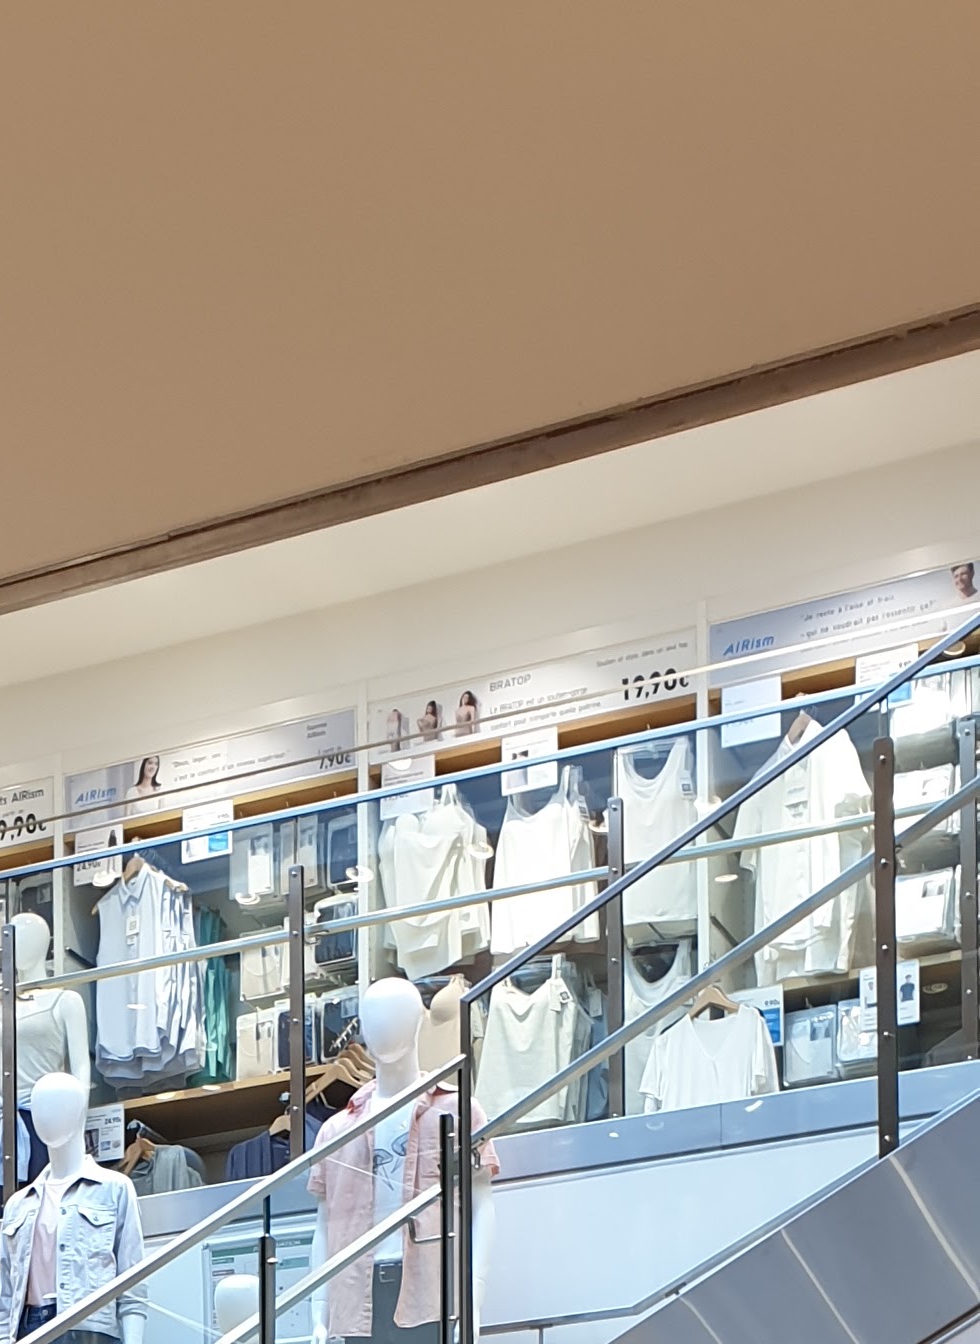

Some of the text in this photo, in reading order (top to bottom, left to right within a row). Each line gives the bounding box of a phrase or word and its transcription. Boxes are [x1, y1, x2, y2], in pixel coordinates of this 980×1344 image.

[722, 635, 776, 657] AIRism
[489, 674, 532, 692] BRATOP
[11, 789, 44, 803] AIRism
[75, 786, 117, 805] AIRism
